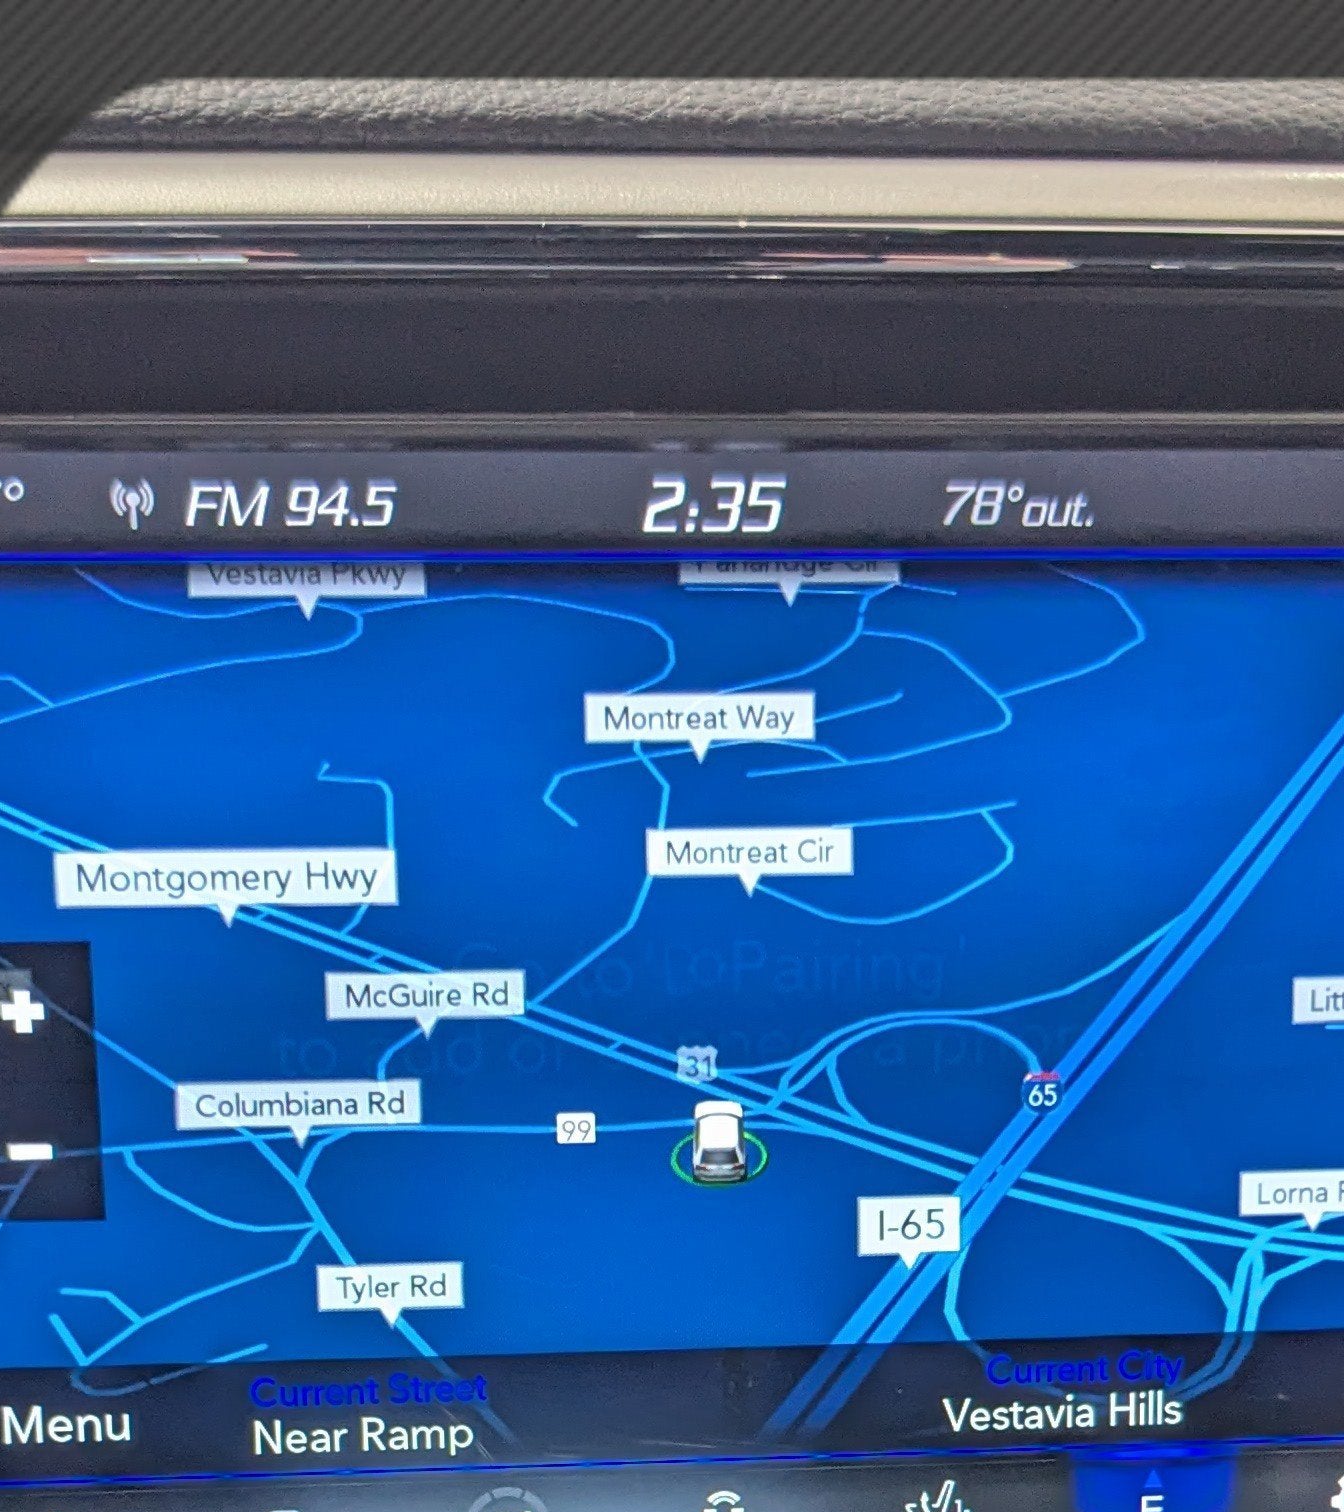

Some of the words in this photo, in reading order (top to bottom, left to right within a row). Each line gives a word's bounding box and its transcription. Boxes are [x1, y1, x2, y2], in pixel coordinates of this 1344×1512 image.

[186, 486, 270, 527] FM
[285, 482, 397, 528] 94.5
[641, 476, 787, 534] 2:35
[206, 562, 320, 586] Vestavia
[331, 562, 407, 590] Pkwy
[604, 703, 728, 734] Montreat
[736, 703, 795, 736] Way
[665, 838, 789, 867] Montreat
[797, 838, 835, 866] Cir
[76, 862, 292, 901] Montgomery
[307, 861, 377, 898] Hwy
[345, 982, 462, 1009] McGuire
[472, 982, 509, 1008] Rd
[685, 1054, 714, 1078] 31
[195, 1091, 358, 1117] Columbiana
[368, 1091, 405, 1116] Rd
[1026, 1083, 1058, 1108] 65
[561, 1119, 592, 1142] 99
[1256, 1181, 1328, 1206] Lorna
[877, 1209, 945, 1242] I-65
[336, 1276, 401, 1303] Tyler
[410, 1274, 447, 1298] Rd
[985, 1356, 1109, 1385] Current
[1118, 1351, 1183, 1385] City
[250, 1378, 380, 1408] Current
[388, 1374, 488, 1405] Street
[1, 1405, 132, 1445] Menu
[942, 1397, 1097, 1432] Vestavia
[1108, 1394, 1183, 1426] Hills
[253, 1421, 351, 1456] Near
[360, 1419, 475, 1458] Ramp
